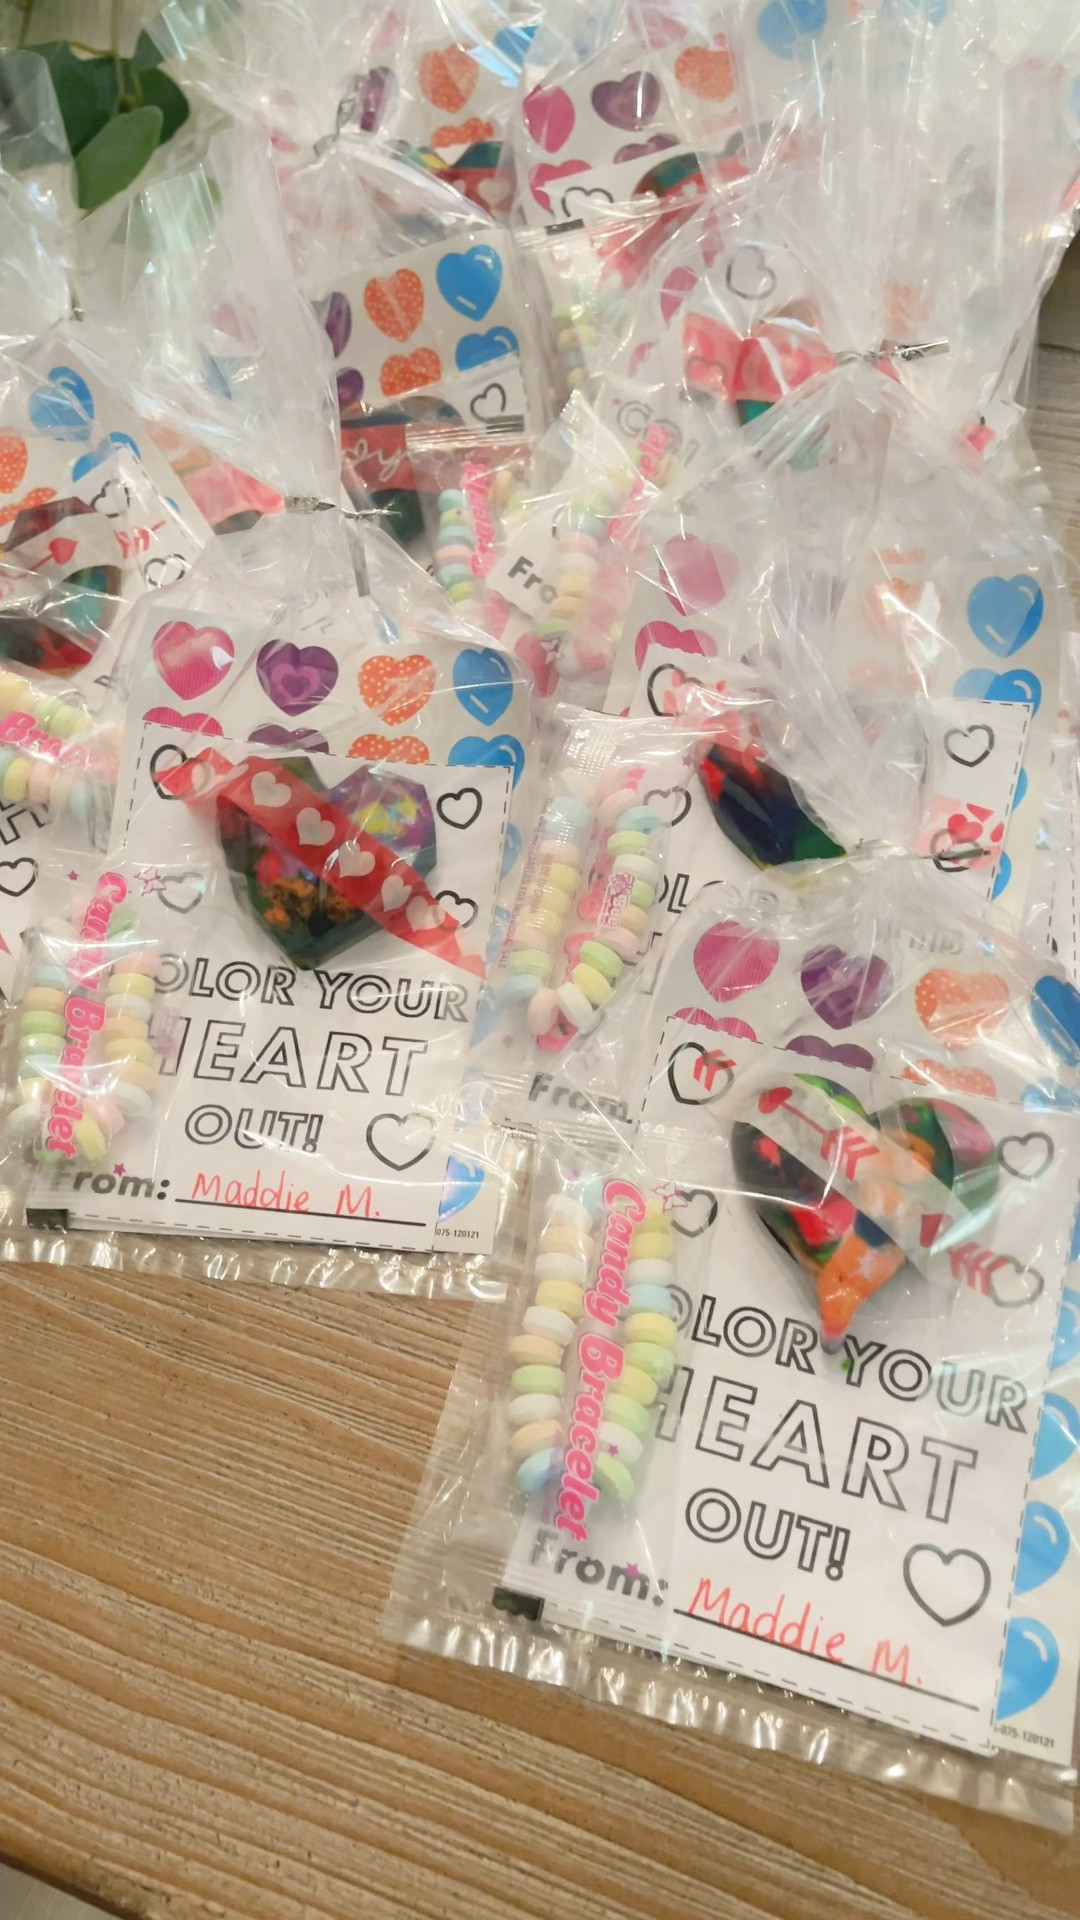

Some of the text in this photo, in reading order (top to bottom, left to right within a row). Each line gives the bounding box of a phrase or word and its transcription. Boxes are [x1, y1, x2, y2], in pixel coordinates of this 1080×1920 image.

[508, 556, 558, 604] Fro
[154, 952, 469, 1023] OLOR YOUR
[185, 1104, 324, 1153] OUT!
[191, 1170, 381, 1218] Maddie M.
[556, 1178, 647, 1542] Candy Bracelet
[667, 1284, 1028, 1434] OLOR YOUR
[685, 1487, 851, 1582] OUT!
[687, 1576, 923, 1686] Maddie M.
